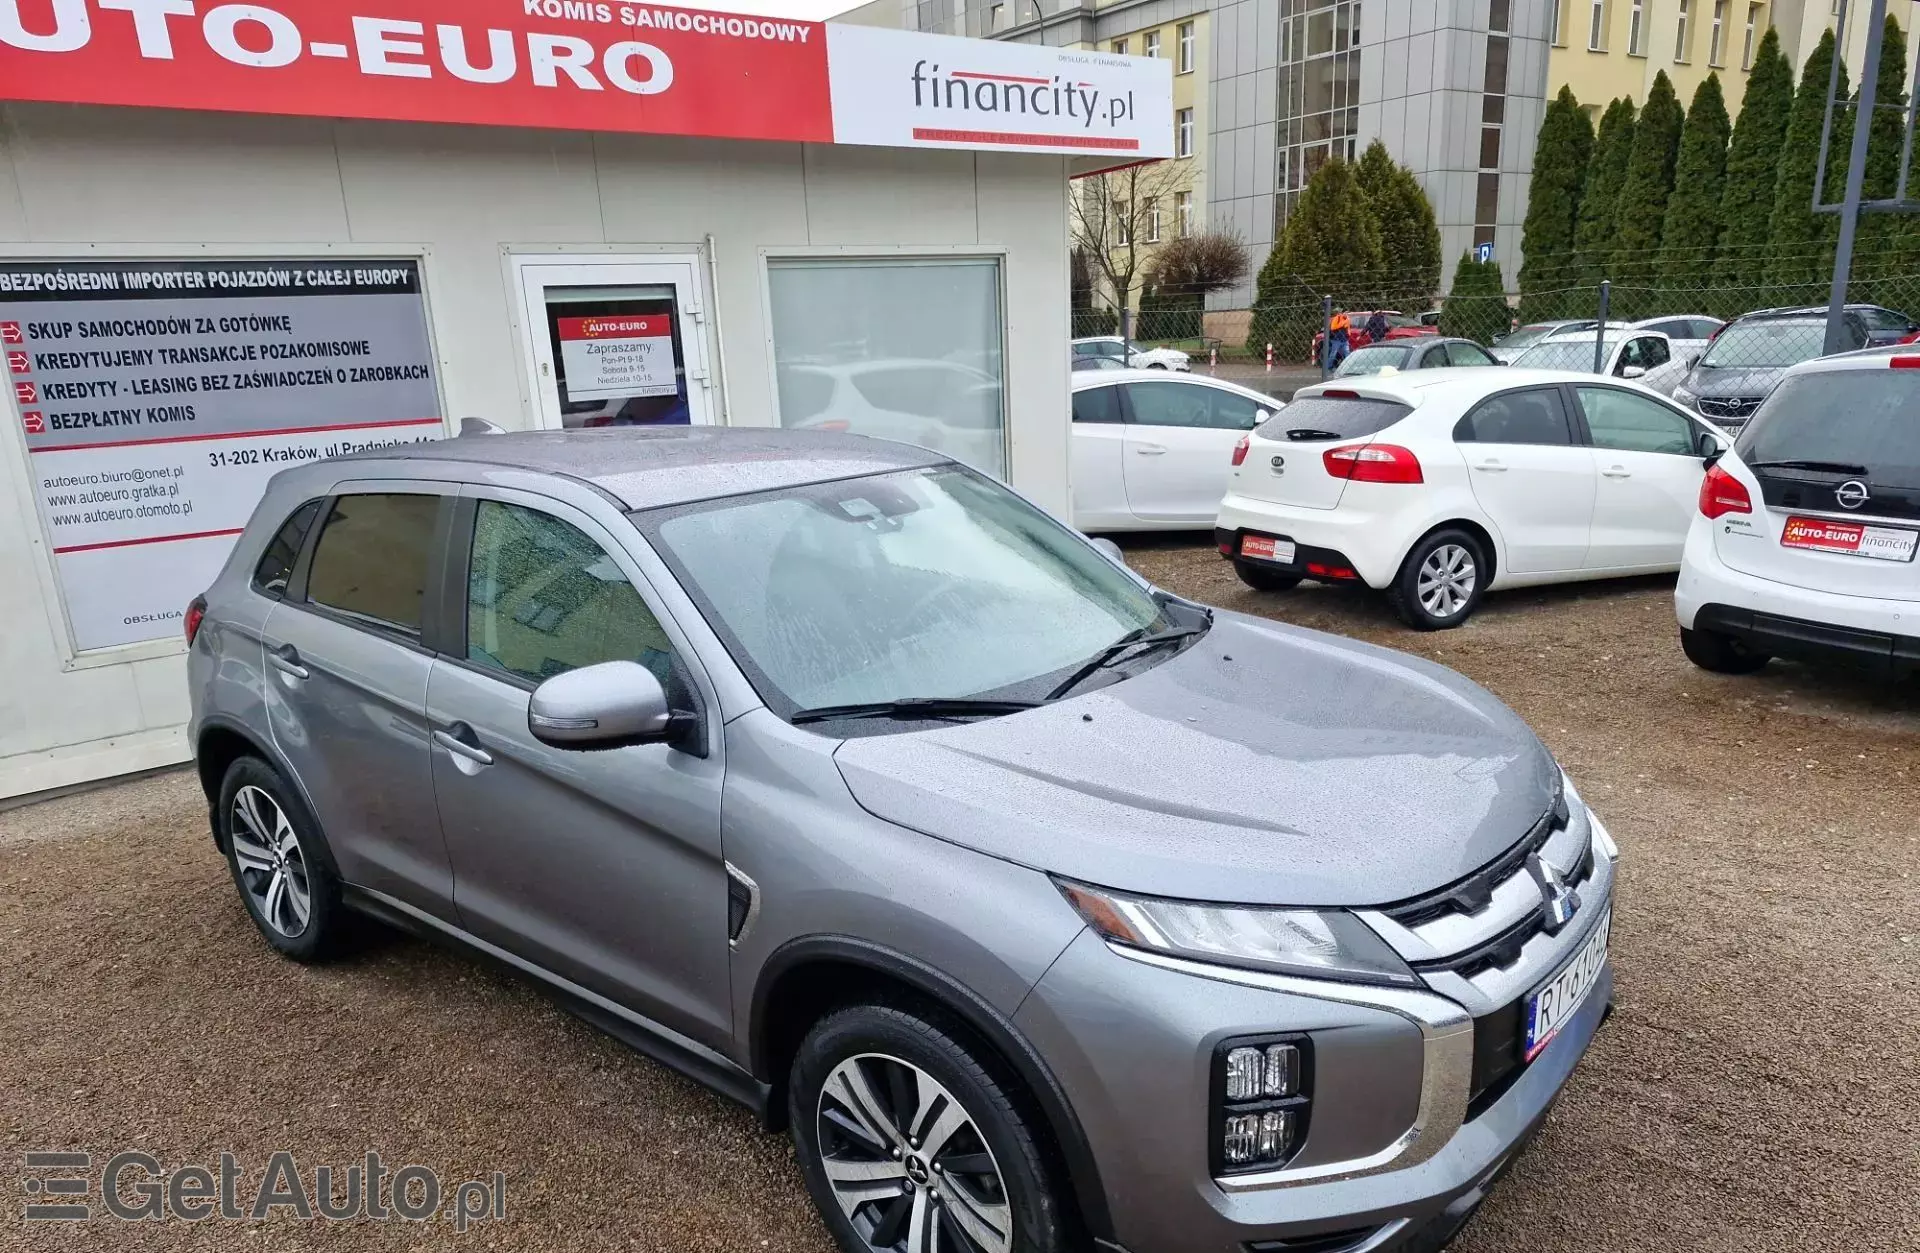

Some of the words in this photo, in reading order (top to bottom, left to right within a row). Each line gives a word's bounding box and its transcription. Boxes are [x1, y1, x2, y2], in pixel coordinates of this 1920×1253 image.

[524, 0, 612, 23] KOMIS
[619, 6, 811, 43] SAMOCHODOWY
[911, 60, 1134, 127] financity.pl
[0, 269, 118, 291] BEZPOŚREDNI
[123, 271, 205, 289] IMPORTER
[208, 267, 290, 288] POJAZDÓW
[294, 270, 305, 286] Z
[307, 269, 351, 286] CAŁEJ
[355, 268, 409, 285] EUROPY
[28, 321, 72, 340] SKUP
[78, 315, 191, 338] SAMOCHODÓW
[196, 318, 216, 334] ZA
[219, 313, 292, 335] GOTÓWKĘ
[589, 321, 648, 332] AUTO-EURO
[35, 349, 153, 370] KREDYTUJEMY
[158, 343, 257, 364] TRANSAKCJE
[260, 340, 370, 360] POZAKOMISOWE
[627, 355, 644, 363] 9-18
[42, 380, 117, 400] KREDYTY
[131, 376, 198, 396] LEASING
[201, 374, 230, 391] BEZ
[233, 365, 334, 390] ZAŚWIADCZEŃ
[336, 368, 347, 384] O
[350, 364, 430, 383] ZAROBKACH
[50, 408, 141, 430] BEZPŁATNY
[147, 404, 196, 424] KOMIS
[208, 449, 259, 467] 31-202
[263, 444, 322, 463] Kraków,
[43, 465, 185, 489] autoeuro.biuro@onet.pl
[47, 482, 180, 507] www.autoeuro.gratka.pl
[52, 499, 194, 526] www.autoeuro.otomoto.pl
[1791, 527, 1858, 542] AUTO-EURO
[123, 610, 183, 625] OBSŁUGA
[1540, 972, 1567, 1034] RT
